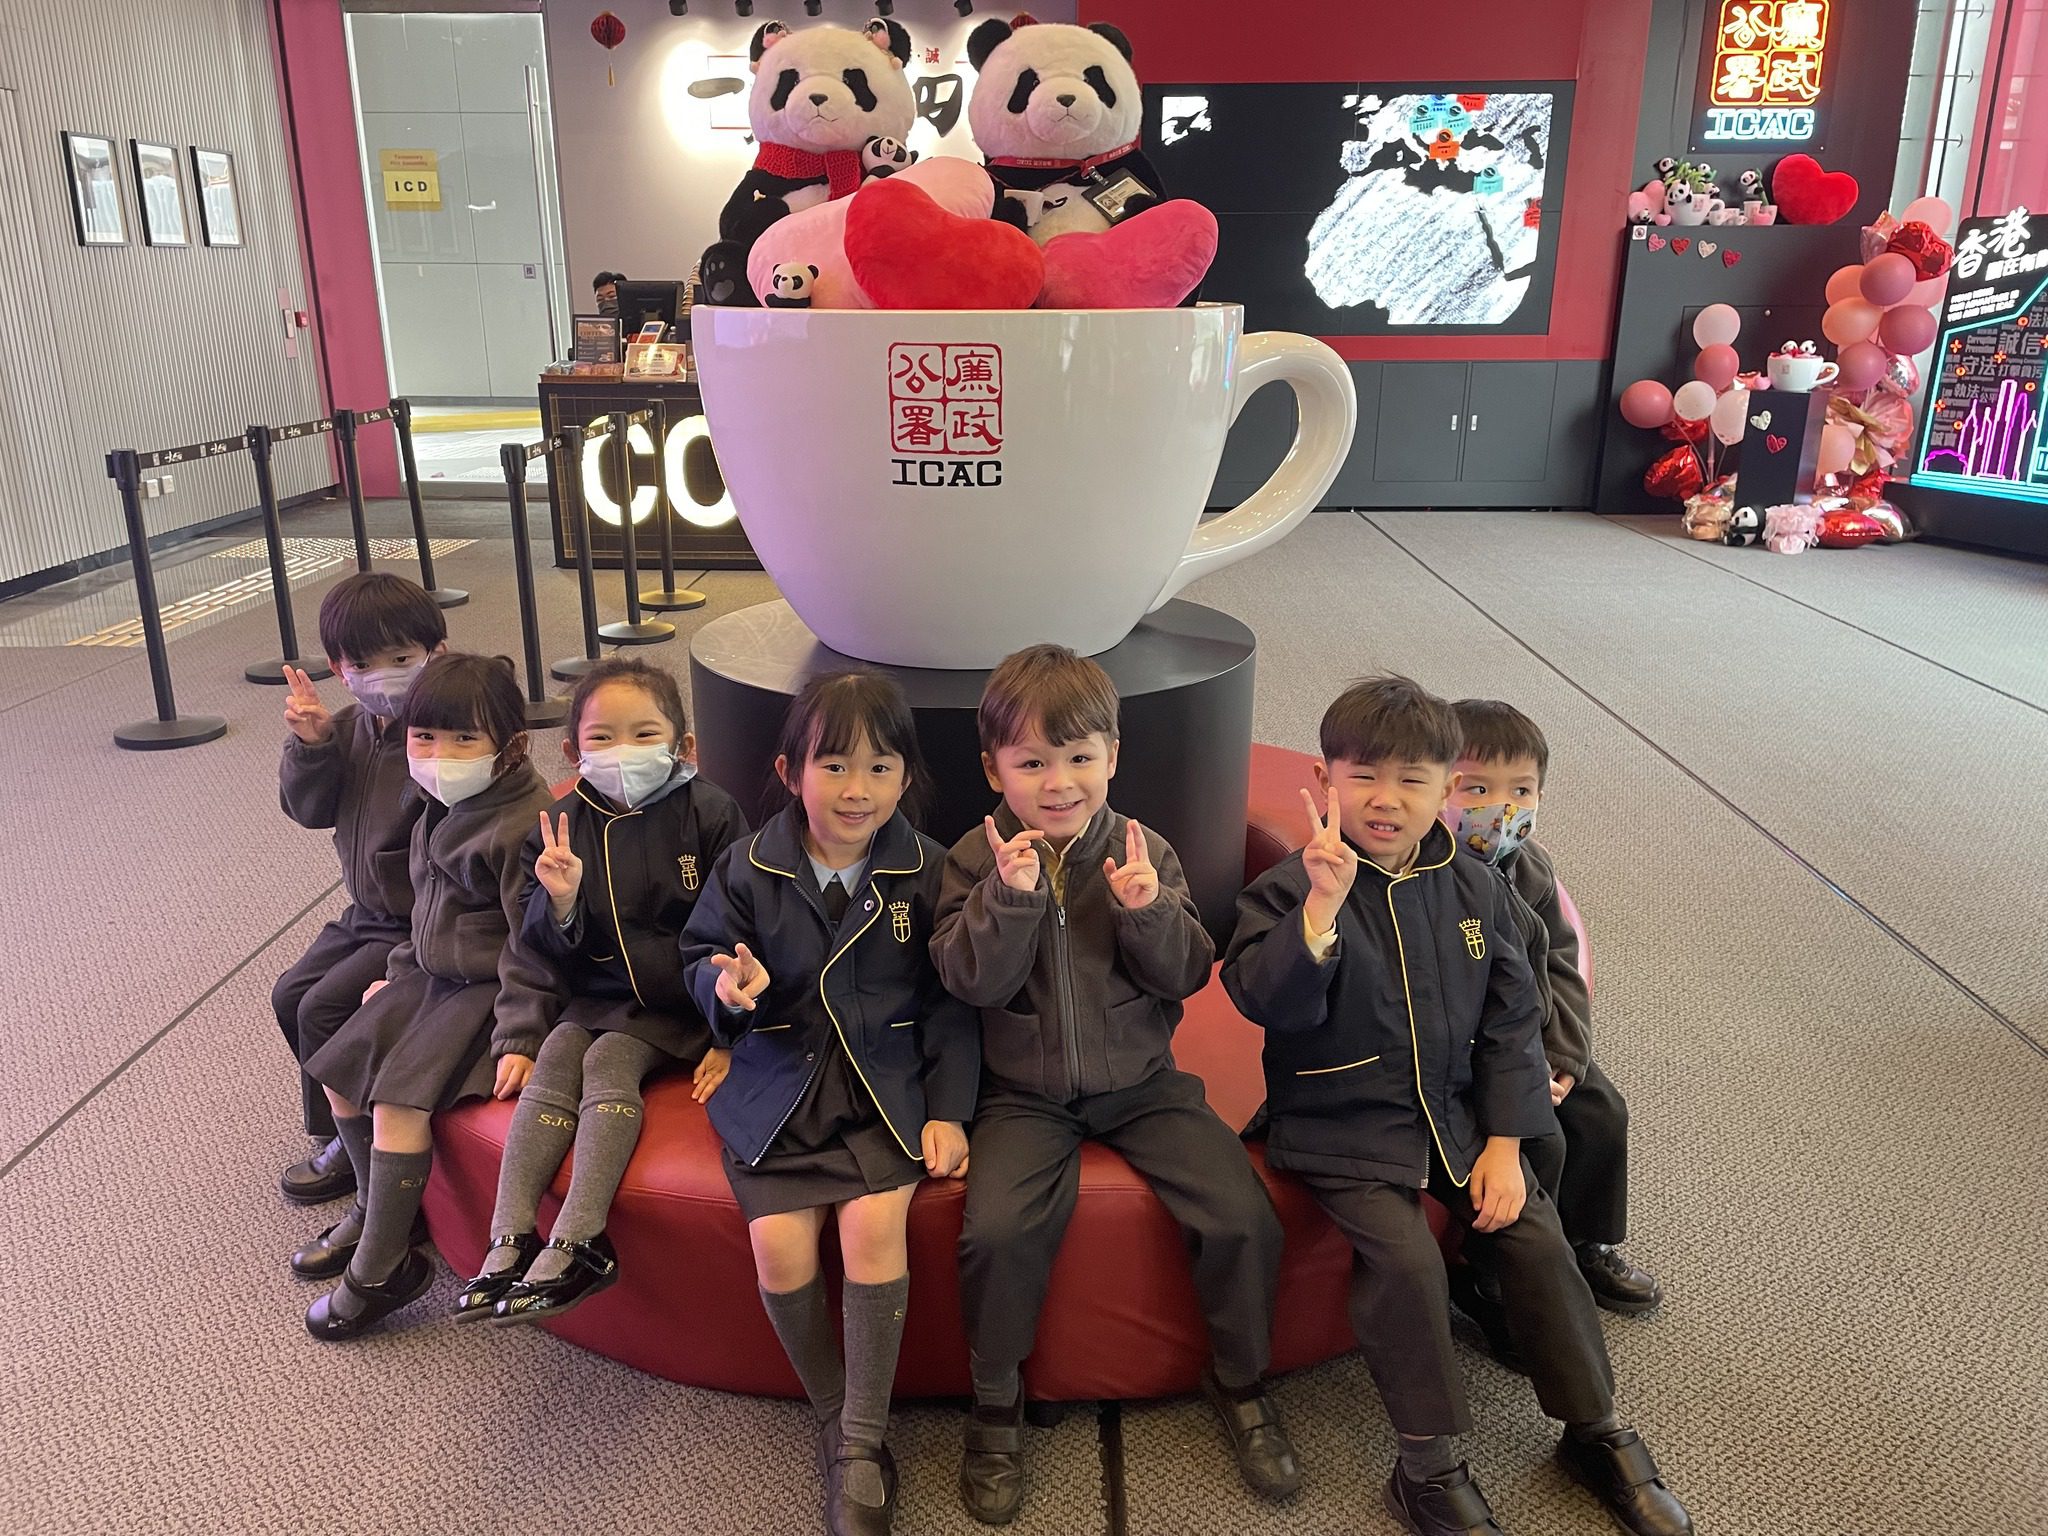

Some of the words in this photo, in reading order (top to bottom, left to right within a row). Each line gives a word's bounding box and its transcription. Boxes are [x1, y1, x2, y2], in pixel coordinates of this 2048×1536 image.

[1704, 108, 1815, 140] ICAC
[1951, 206, 2031, 279] 香港
[1998, 331, 2042, 355] 誠信
[891, 458, 1002, 487] ICAC
[538, 1113, 576, 1131] SJC
[596, 1103, 637, 1118] SJC
[400, 1177, 424, 1188] SJ
